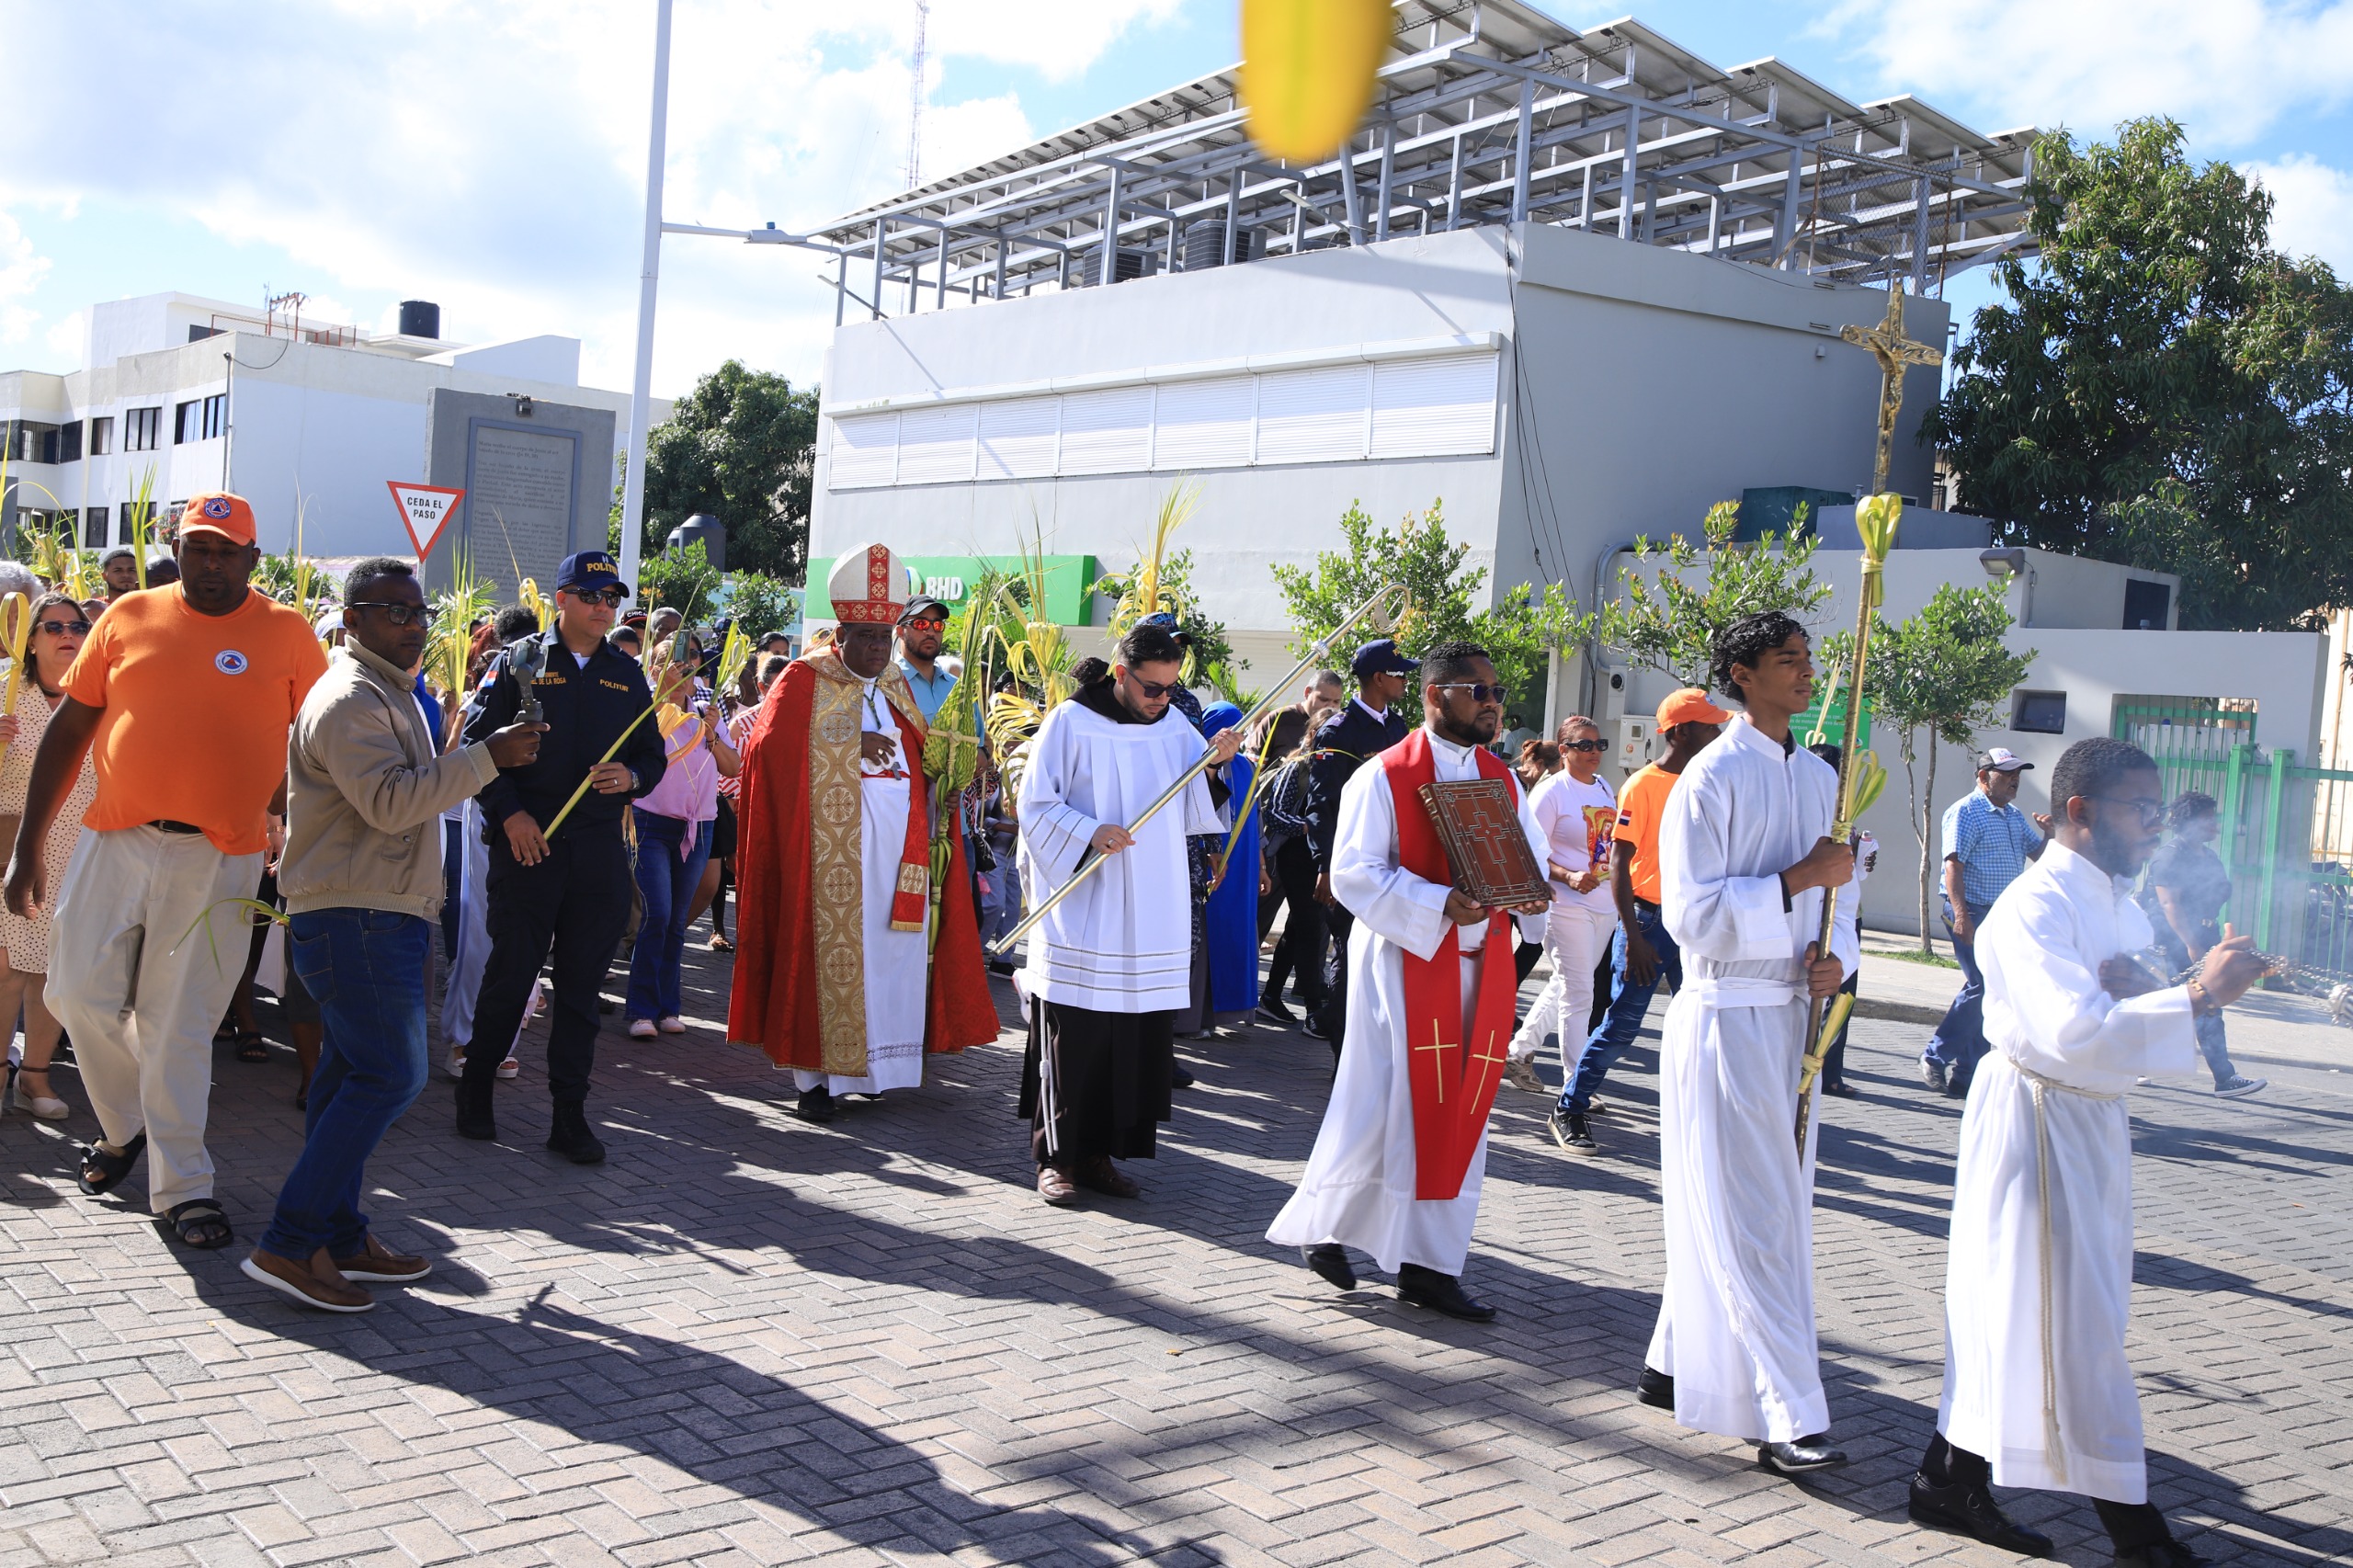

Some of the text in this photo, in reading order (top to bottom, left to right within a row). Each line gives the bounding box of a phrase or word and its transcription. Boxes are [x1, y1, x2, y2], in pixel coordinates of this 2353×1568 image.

[407, 496, 443, 509] CEDA EL
[413, 508, 436, 519] PASO
[926, 577, 963, 600] BHD
[599, 678, 629, 692] POLITUR
